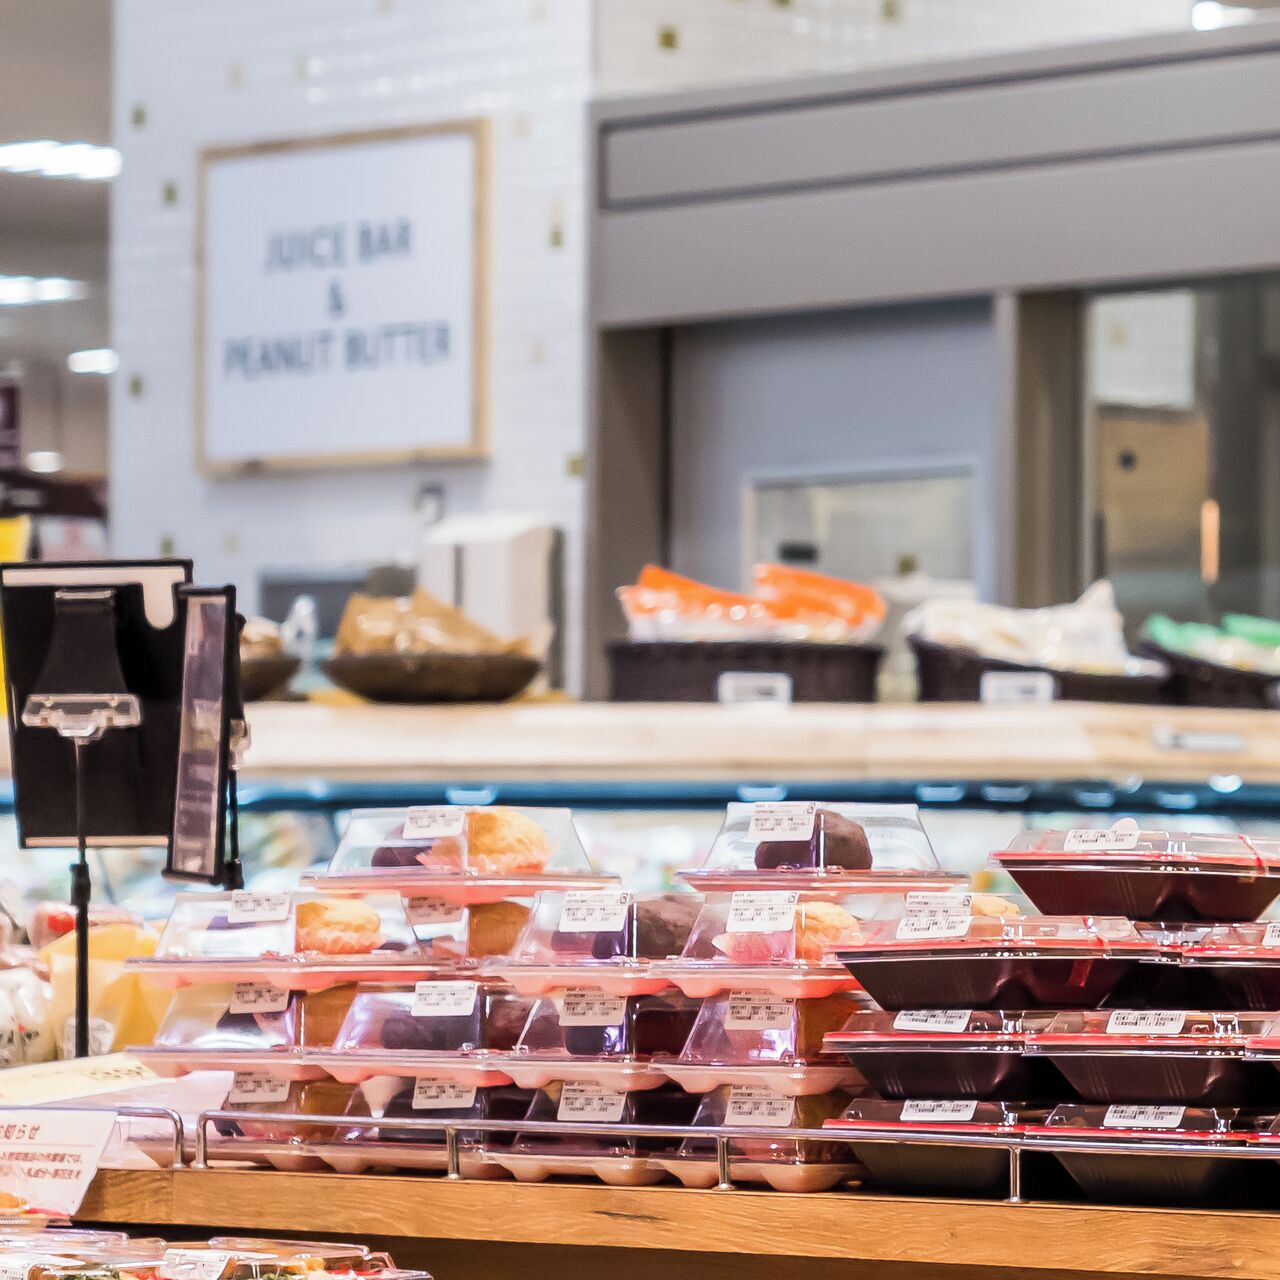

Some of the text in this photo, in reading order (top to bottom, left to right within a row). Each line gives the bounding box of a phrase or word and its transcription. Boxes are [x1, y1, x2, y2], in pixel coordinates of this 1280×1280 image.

[264, 216, 412, 272] JUICE BAR
[224, 320, 451, 380] PEANUT BUTTER
